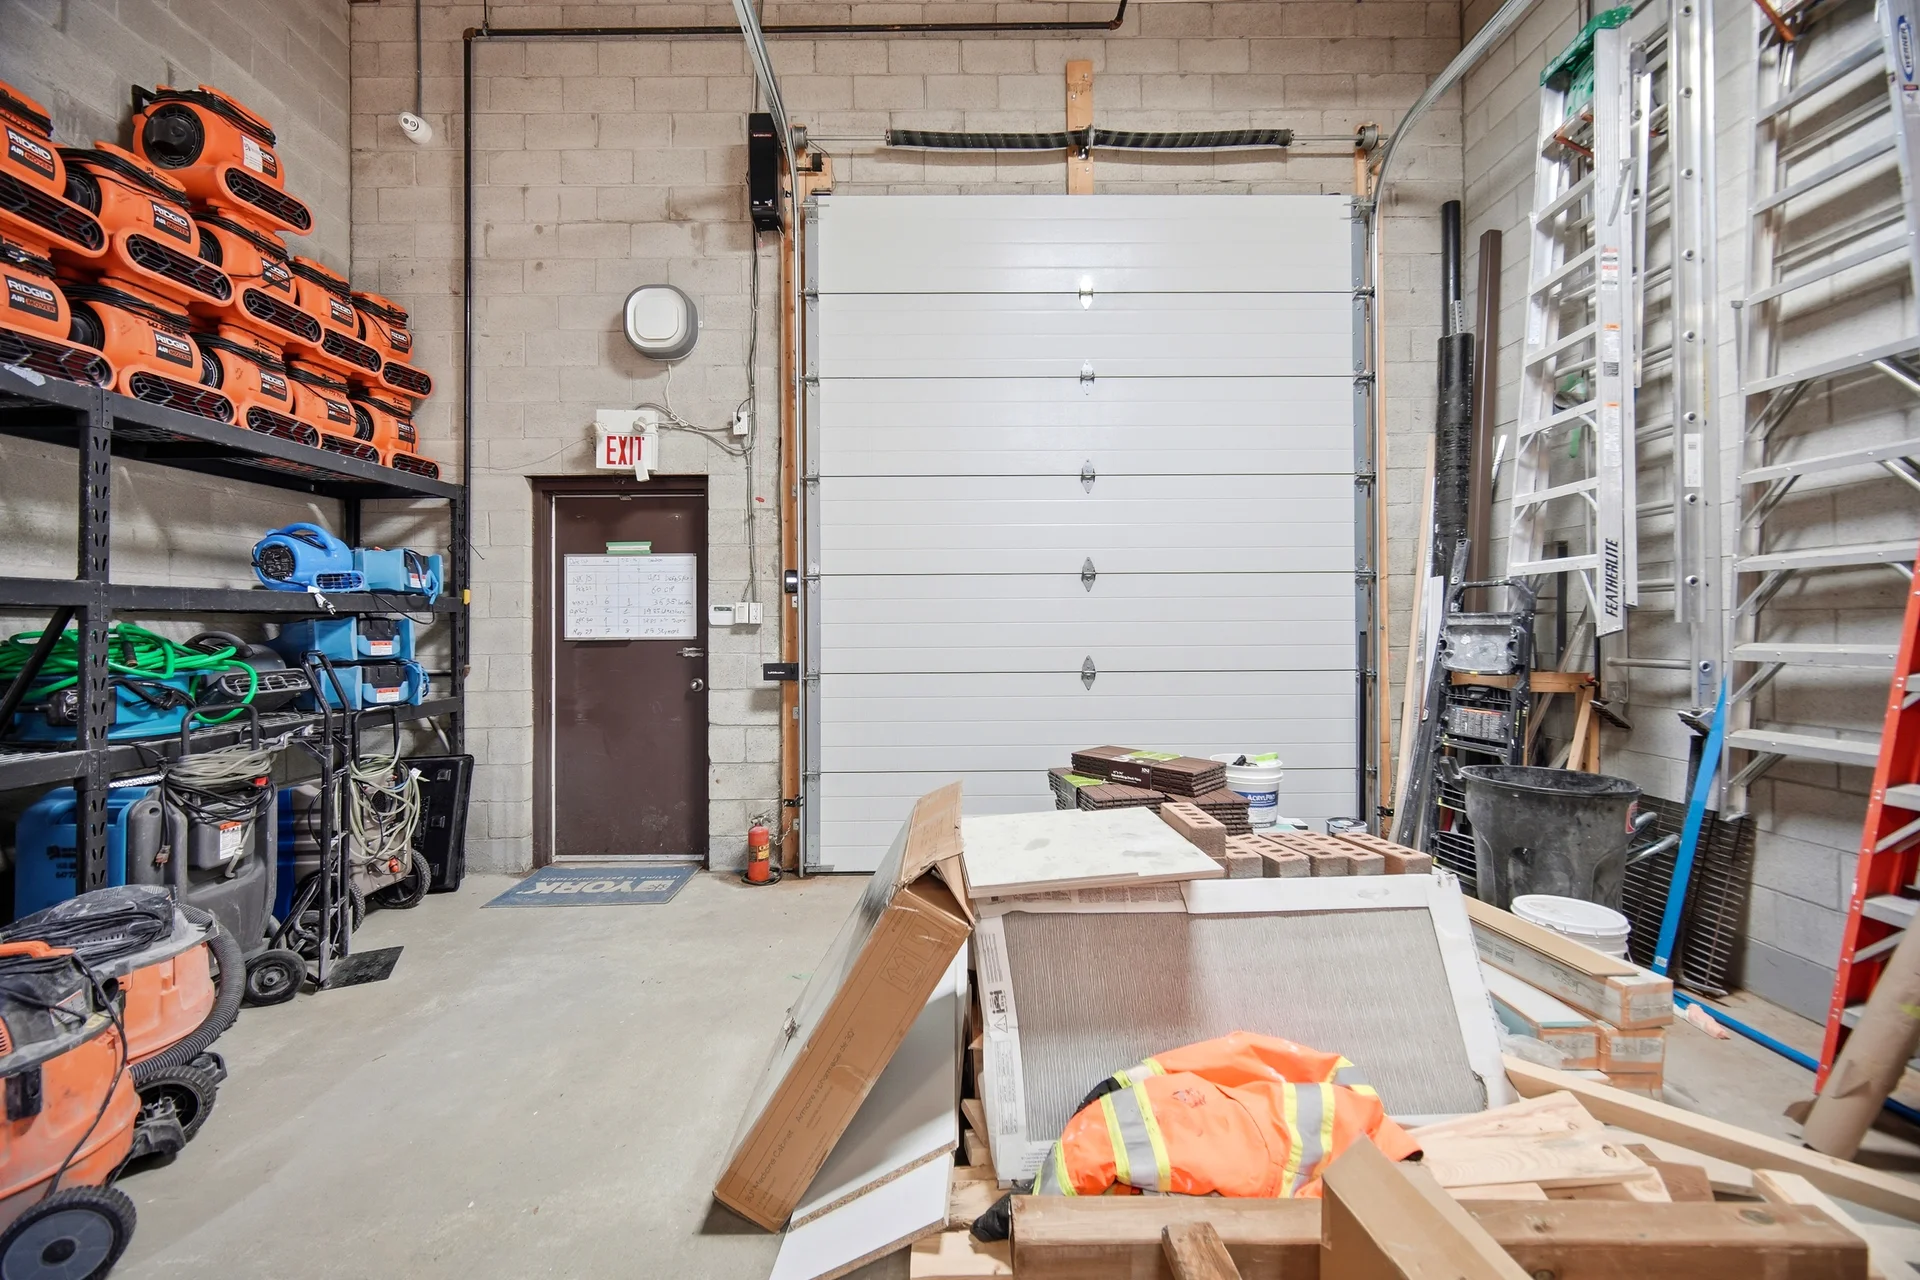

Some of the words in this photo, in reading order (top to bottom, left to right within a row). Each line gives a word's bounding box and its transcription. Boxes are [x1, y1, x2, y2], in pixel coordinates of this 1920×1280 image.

[1900, 27, 1912, 68] WERNER
[8, 130, 52, 160] RIDGID
[11, 145, 24, 156] AIR
[26, 152, 53, 172] MOVER
[153, 204, 187, 226] RIDGID
[156, 216, 166, 225] AIR
[8, 280, 53, 301] RIDGID
[11, 294, 24, 304] AIR
[26, 299, 56, 314] MOVER
[155, 334, 190, 352] RIDGID
[158, 346, 168, 354] AIR
[260, 372, 285, 386] RIDGID
[606, 436, 644, 465] EXIT
[1605, 538, 1618, 618] FEATHERLITE
[516, 880, 633, 894] YORK
[796, 1093, 816, 1124] Armoire
[817, 1055, 842, 1091] pharmacie
[754, 1156, 777, 1191] Medicine
[773, 1130, 794, 1157] Cabinet
